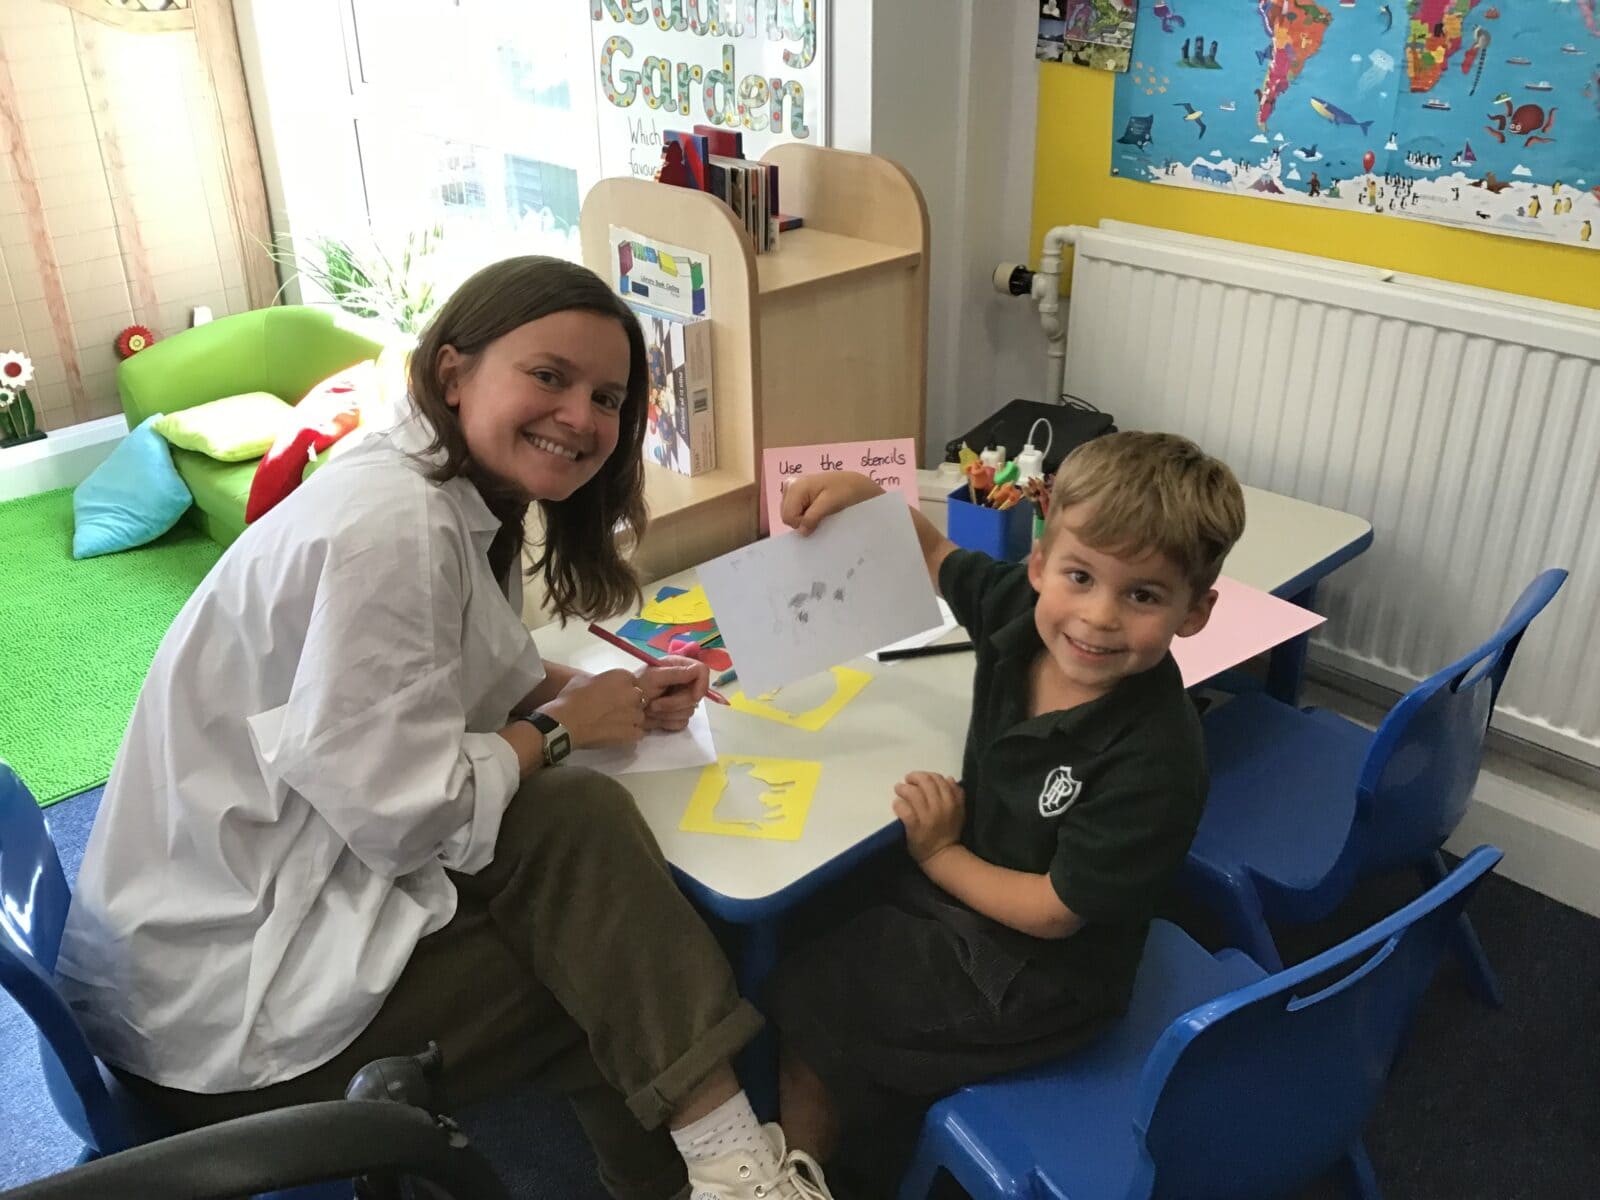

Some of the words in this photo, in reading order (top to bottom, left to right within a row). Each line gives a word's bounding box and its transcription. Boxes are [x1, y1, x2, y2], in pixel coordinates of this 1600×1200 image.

[600, 35, 810, 139] Garden
[627, 116, 663, 146] Which
[779, 461, 803, 475] Use
[820, 454, 844, 471] the
[860, 447, 906, 467] stencils
